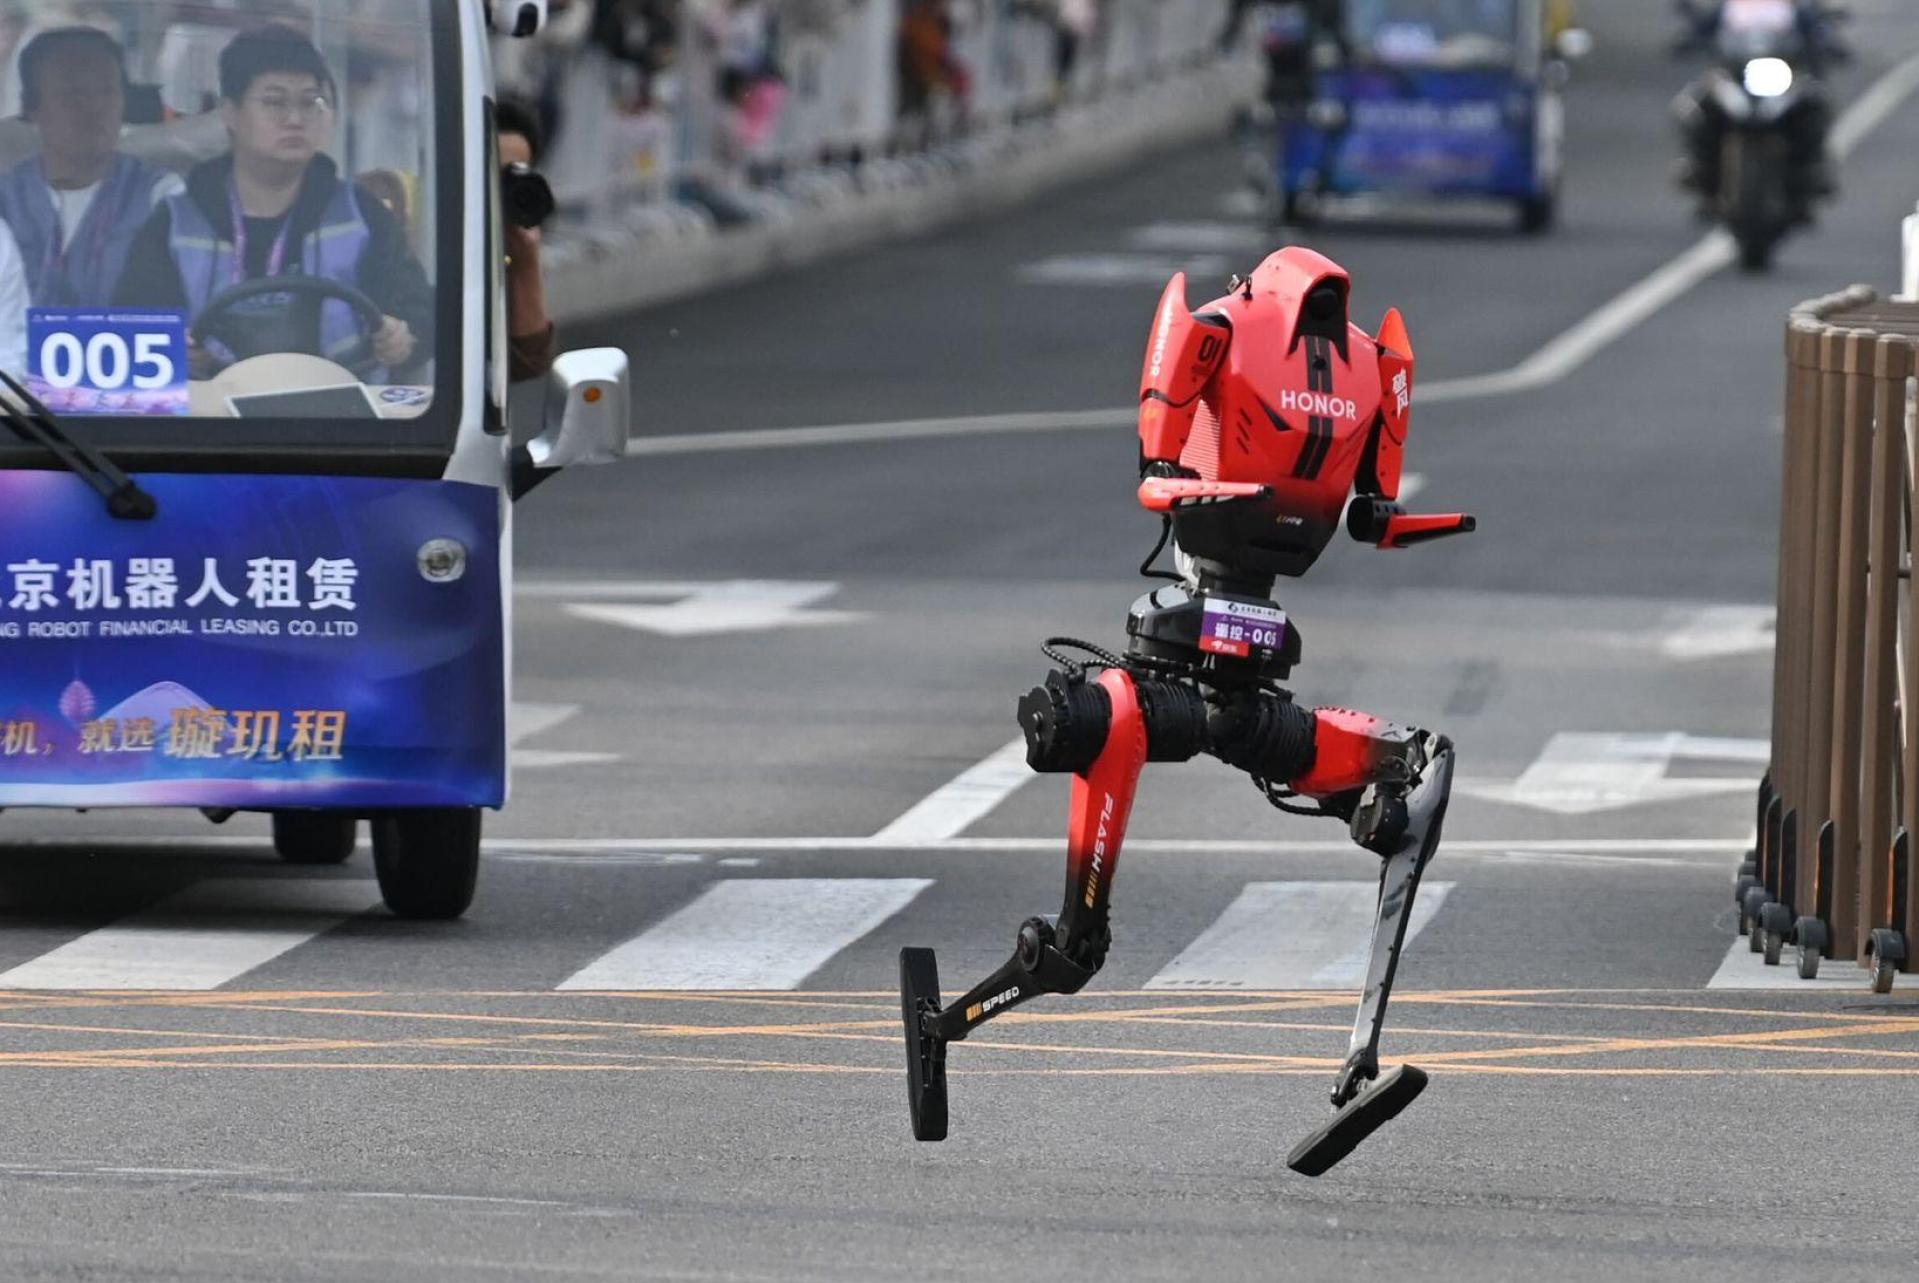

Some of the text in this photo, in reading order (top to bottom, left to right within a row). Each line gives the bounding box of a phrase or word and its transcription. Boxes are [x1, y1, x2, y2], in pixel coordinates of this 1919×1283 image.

[40, 332, 174, 389] 005
[1281, 389, 1356, 420] HONOR
[0, 556, 359, 611] 京机器人租赁
[27, 621, 92, 638] ROBOT
[99, 618, 194, 637] FINANCIAL
[201, 618, 280, 636] LEASING
[287, 620, 359, 637] CO.,LTD
[1091, 791, 1114, 872] FLASH
[982, 986, 1020, 1013] SPEED
